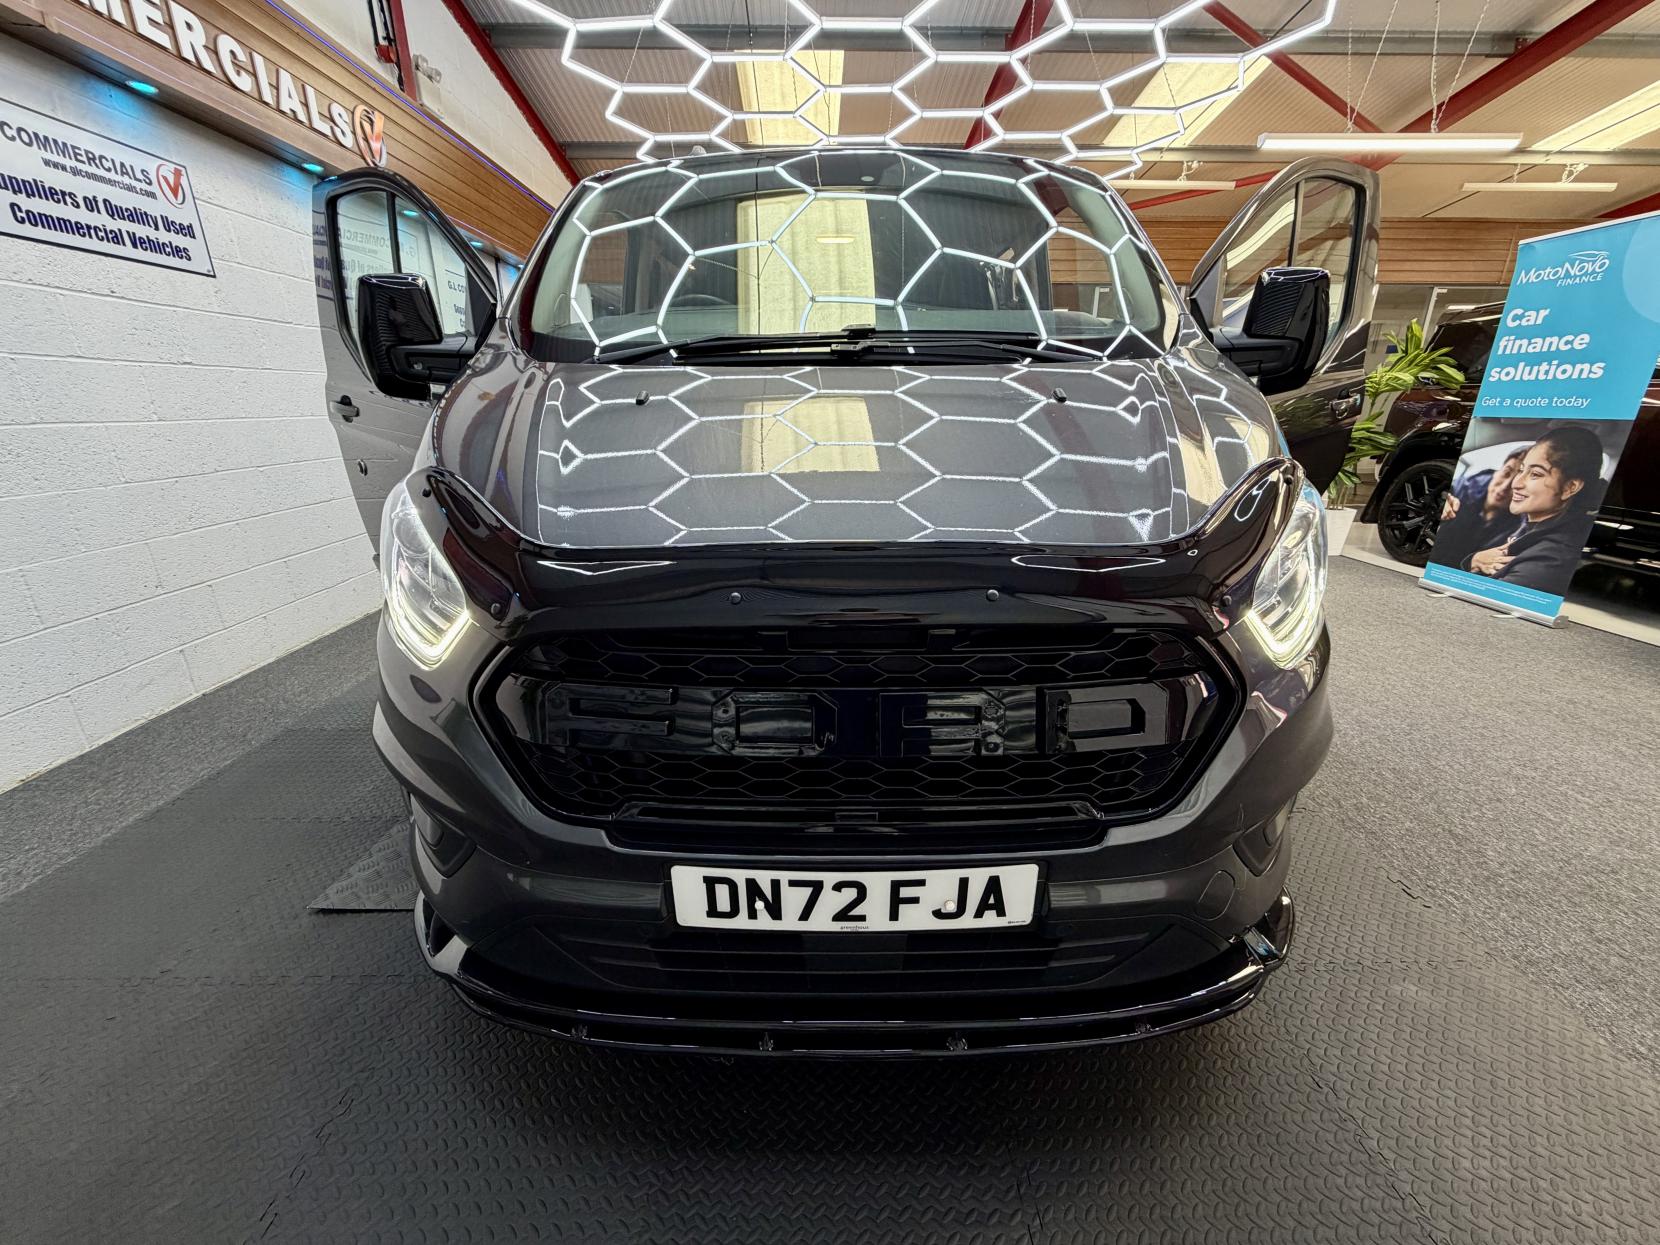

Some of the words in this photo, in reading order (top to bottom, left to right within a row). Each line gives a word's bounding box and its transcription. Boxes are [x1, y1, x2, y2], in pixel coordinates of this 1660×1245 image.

[0, 121, 153, 187] COMMERCIALS
[41, 156, 158, 200] www.glcommercials.com
[9, 202, 126, 247] Commercial
[126, 230, 192, 262] Vehicles
[83, 195, 102, 215] of
[102, 198, 160, 232] Quality
[160, 214, 197, 240] Used
[1516, 256, 1610, 286] MotoNovo
[1556, 272, 1605, 288] FINANCE
[1506, 308, 1550, 328] Car
[1497, 333, 1590, 355] finance
[1489, 360, 1606, 382] solutions
[1481, 396, 1500, 407] Get
[1503, 398, 1510, 406] a
[1514, 397, 1549, 408] quote
[1552, 396, 1592, 409] today
[702, 875, 867, 922] DN72
[888, 874, 1006, 922] FJA
